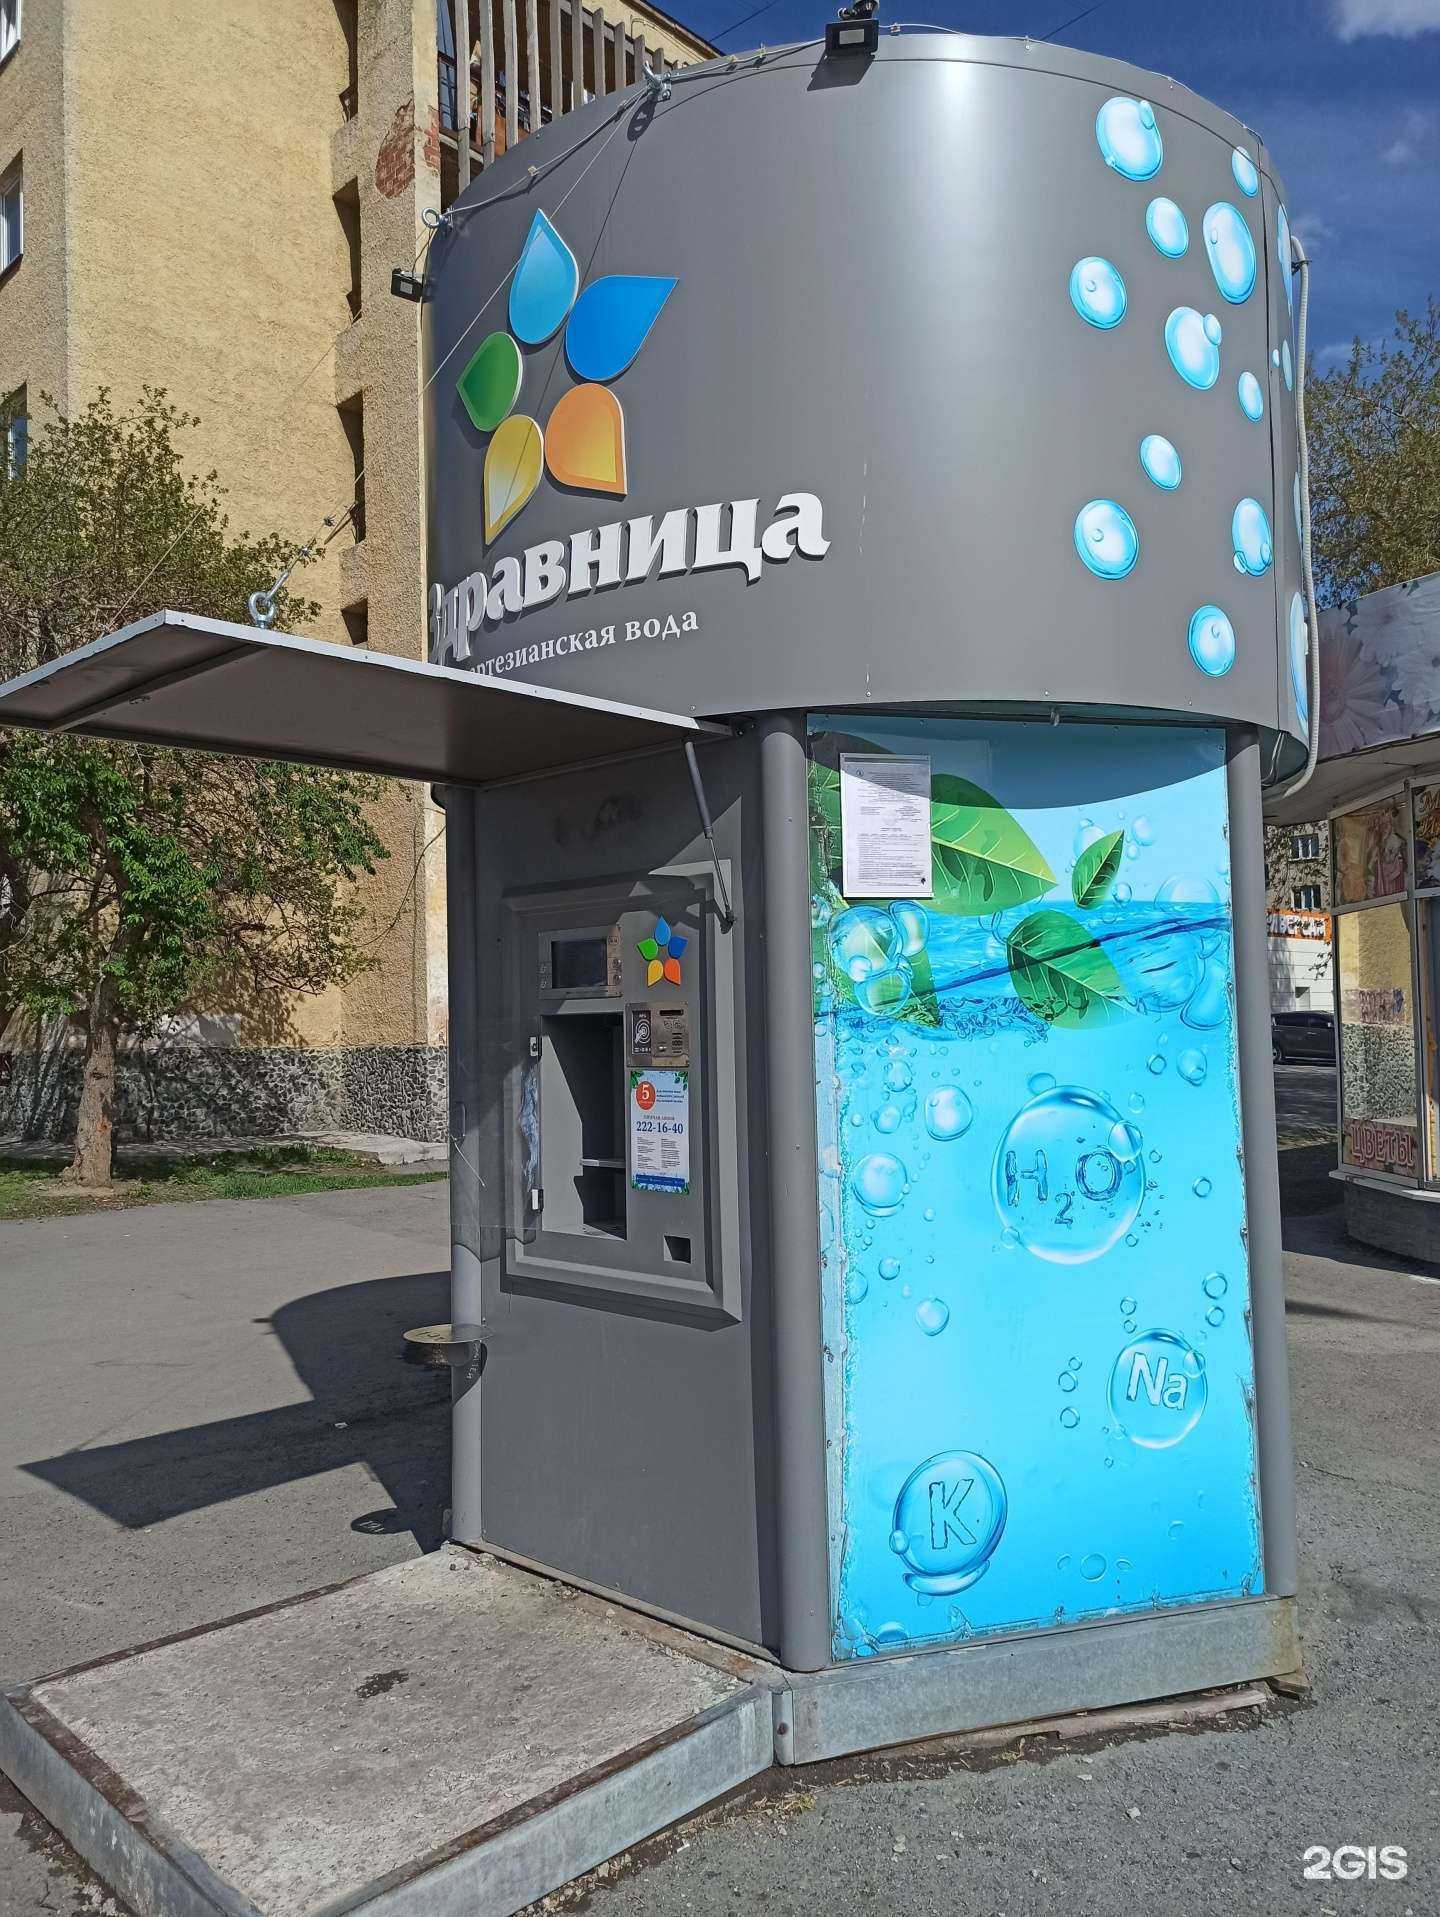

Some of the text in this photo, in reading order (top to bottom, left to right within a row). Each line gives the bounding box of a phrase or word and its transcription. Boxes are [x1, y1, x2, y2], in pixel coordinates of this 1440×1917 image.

[624, 609, 699, 641] вода
[641, 1083, 650, 1100] 5
[636, 1120, 683, 1134] 222-16-40
[1350, 1123, 1415, 1167] ЦВЕТЫ
[1126, 1351, 1188, 1411] Na
[928, 1478, 977, 1550] K
